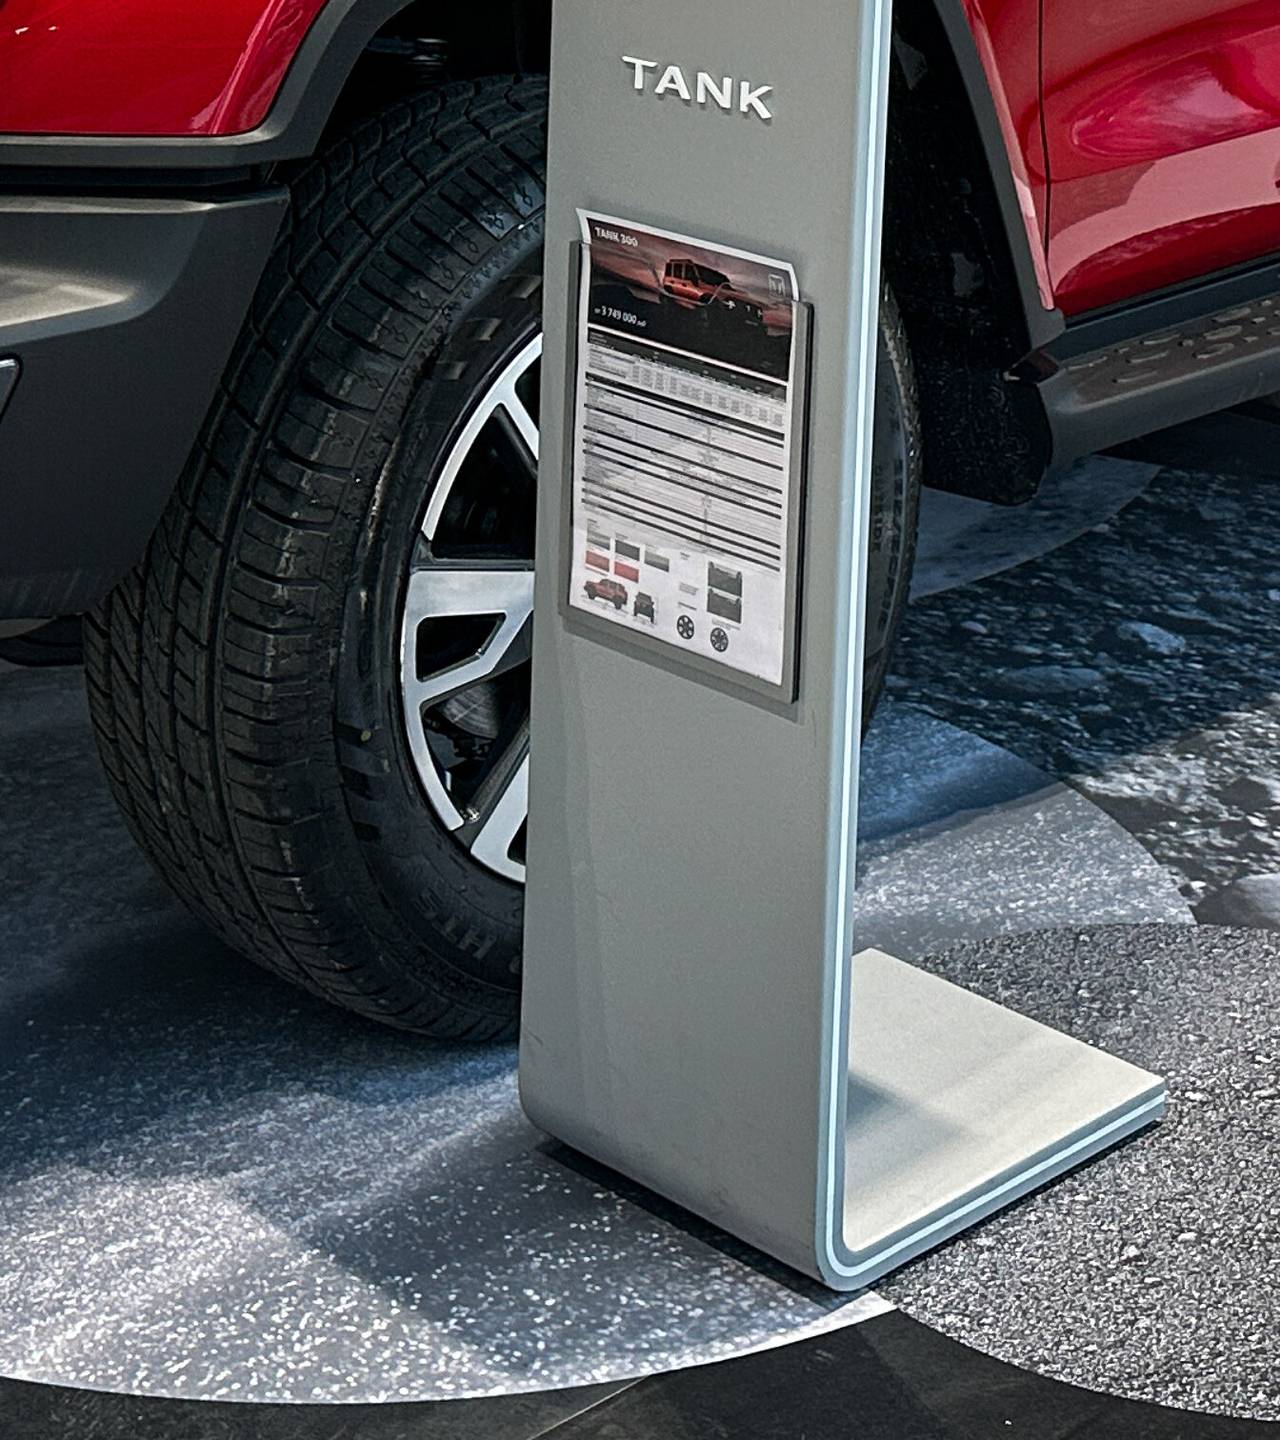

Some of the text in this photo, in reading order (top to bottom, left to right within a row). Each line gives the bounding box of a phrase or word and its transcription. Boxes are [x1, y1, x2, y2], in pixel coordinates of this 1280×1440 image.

[621, 55, 773, 119] TANK
[594, 226, 638, 247] TANK 300
